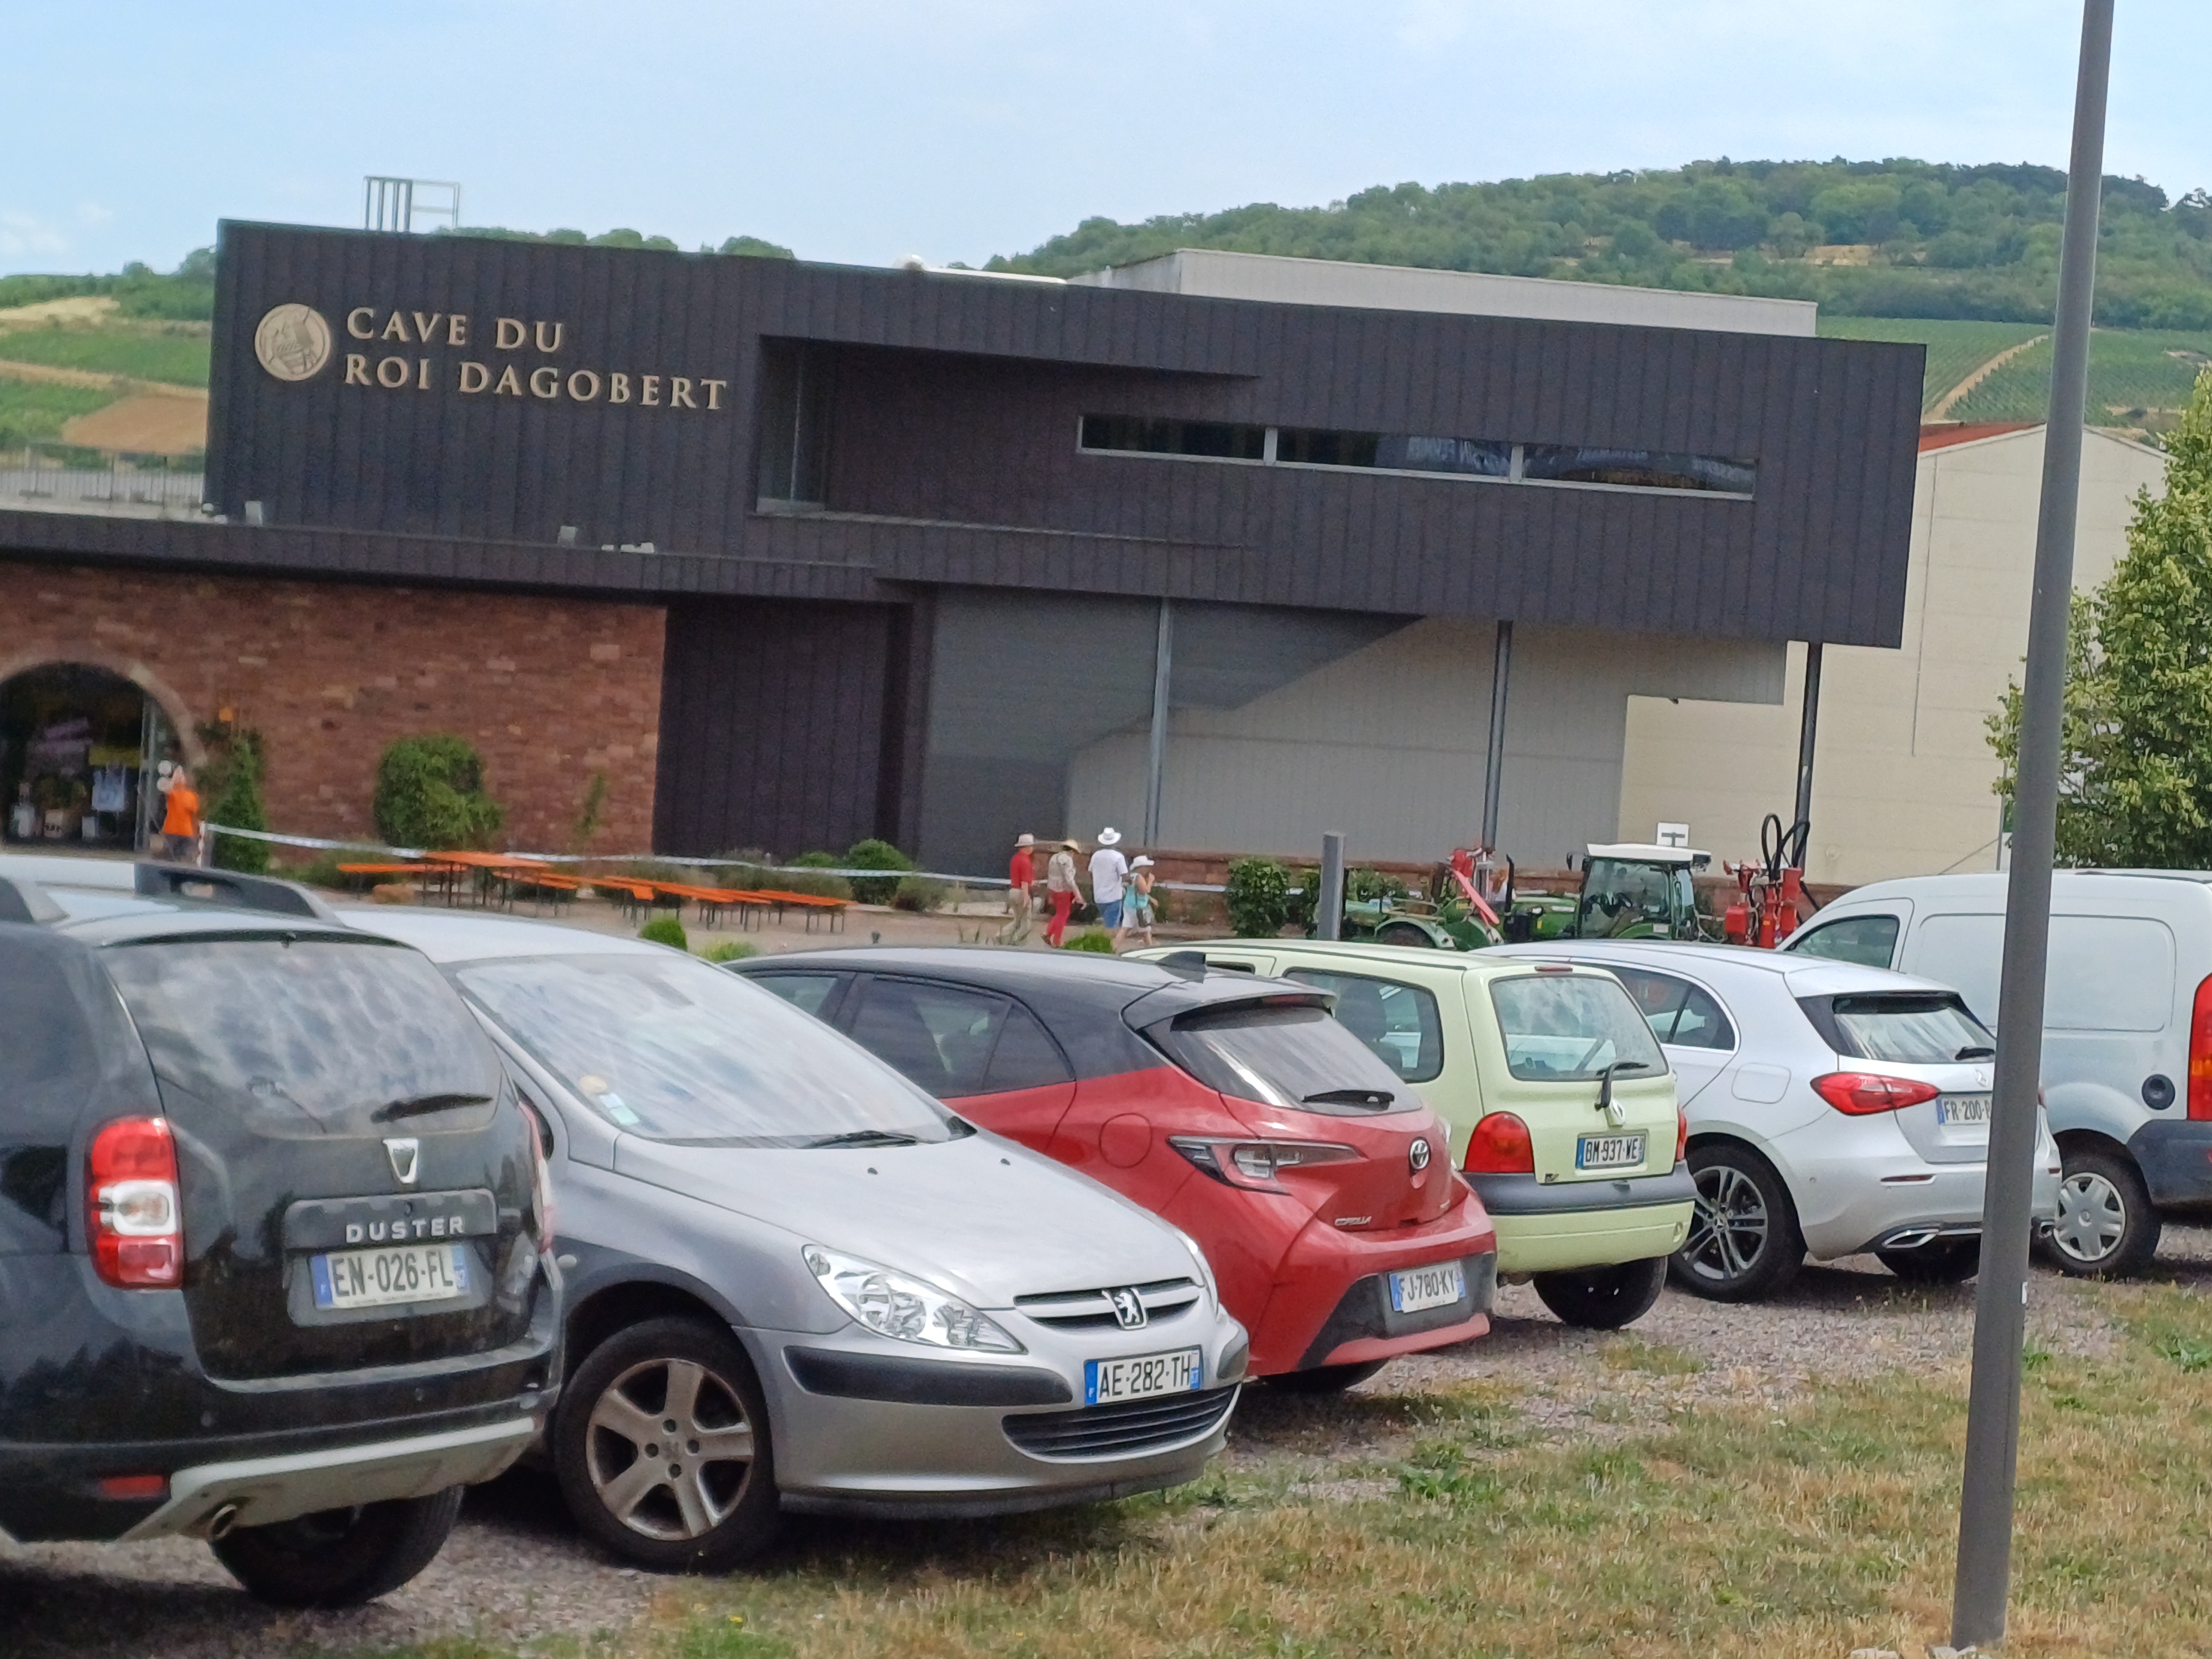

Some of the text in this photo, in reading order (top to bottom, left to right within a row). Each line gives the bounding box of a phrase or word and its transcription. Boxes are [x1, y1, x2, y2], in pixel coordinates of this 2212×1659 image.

[347, 306, 564, 352] CAVE DU
[345, 353, 727, 410] ROI DAGOBERT
[1944, 1099, 1990, 1120] FR-200-P
[346, 1216, 465, 1243] DUSTER
[331, 1249, 453, 1297] EN-026-FL
[1098, 1354, 1191, 1399] AE-282-TH
